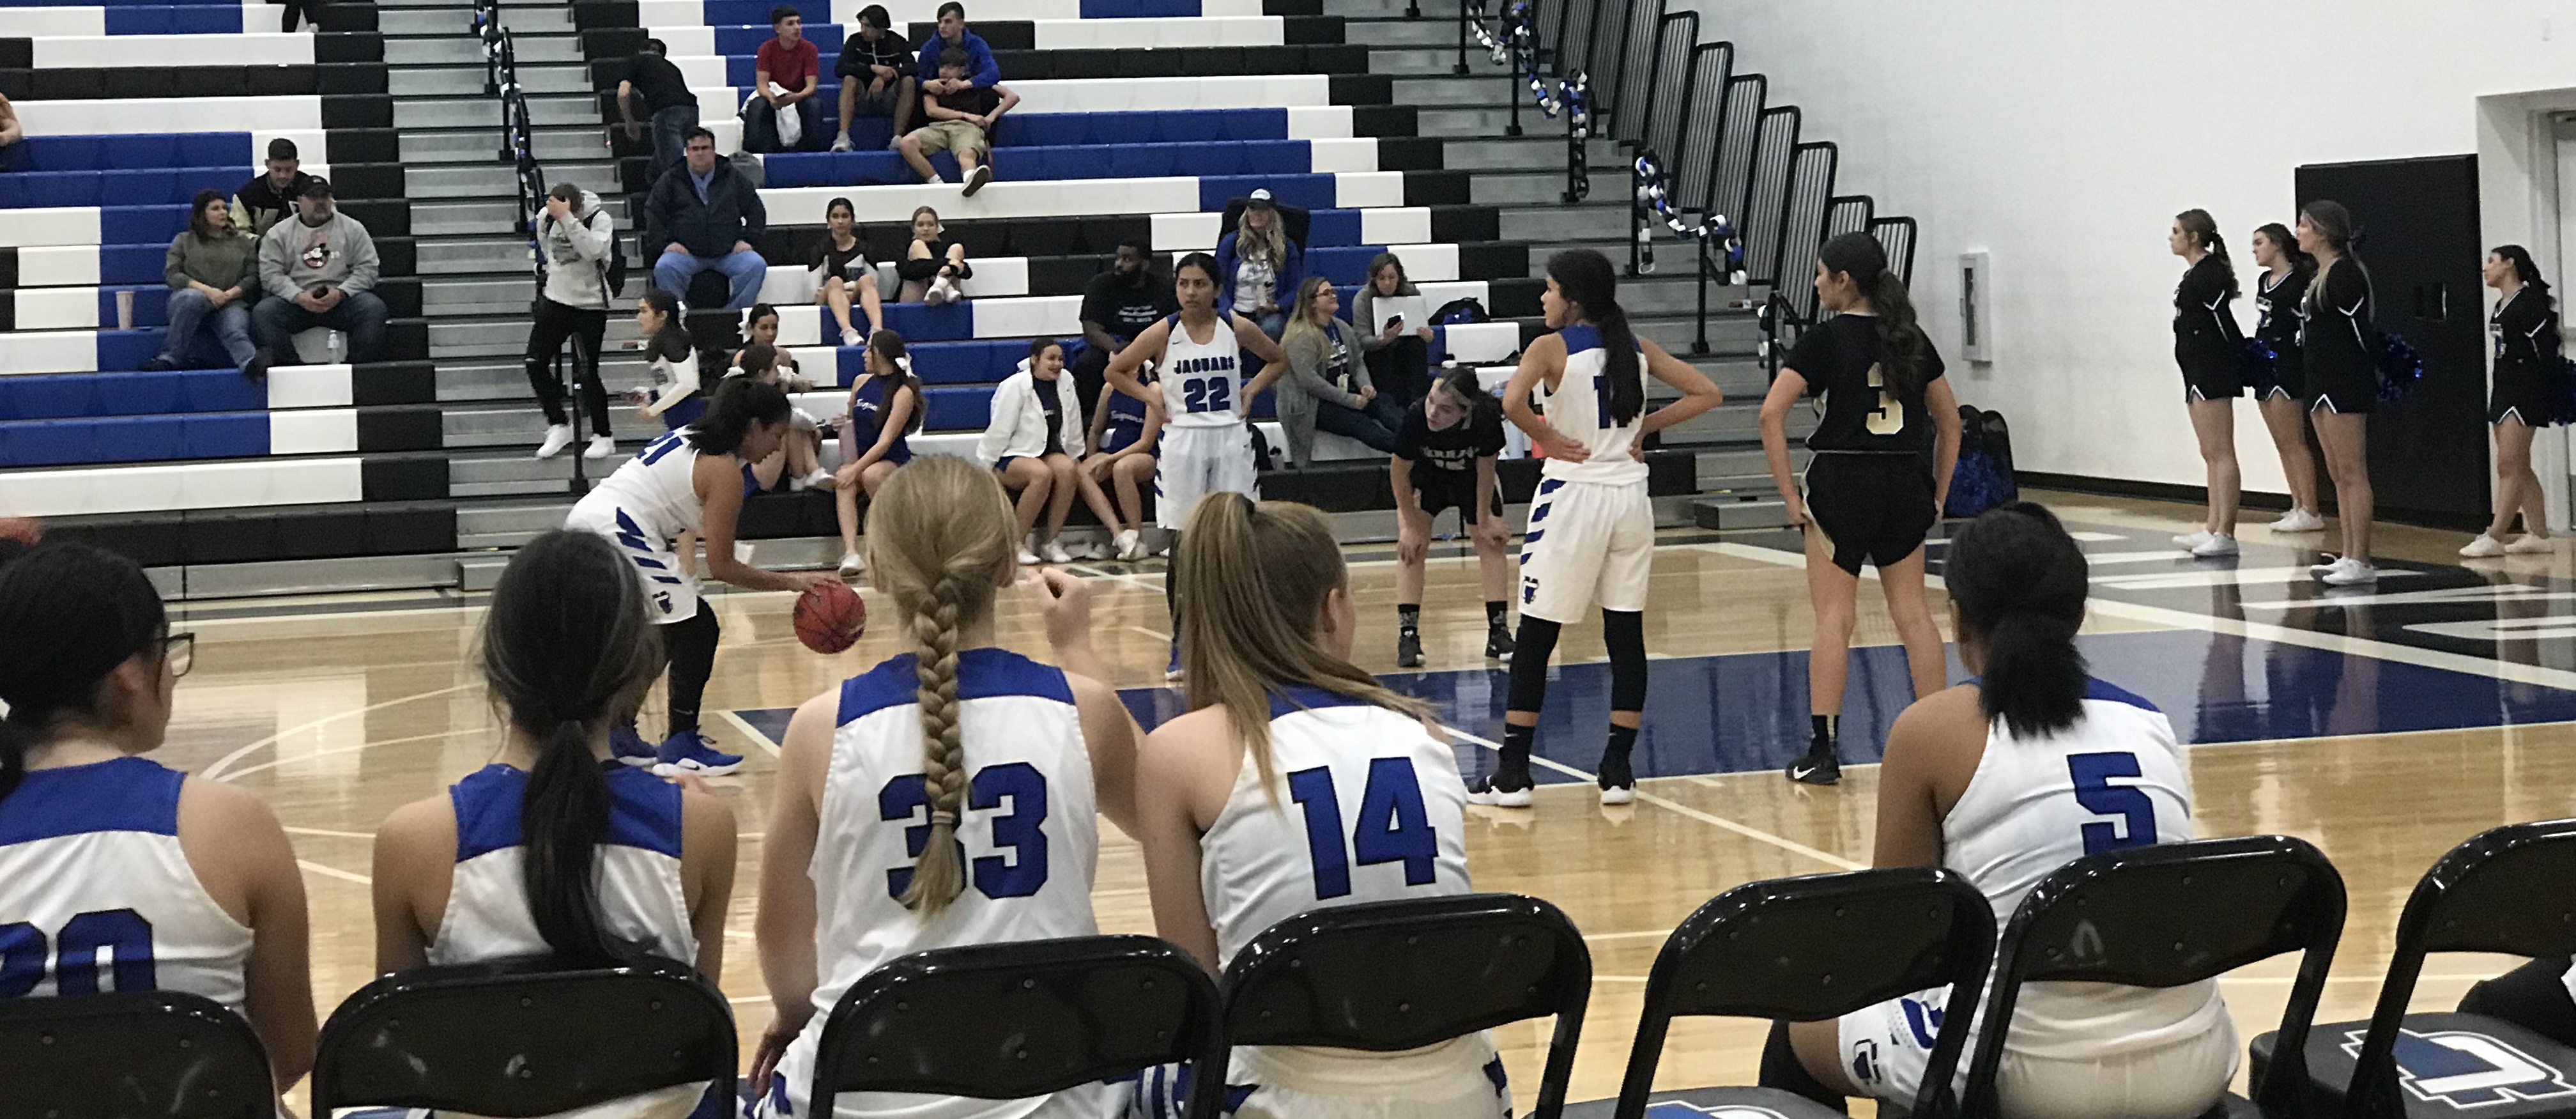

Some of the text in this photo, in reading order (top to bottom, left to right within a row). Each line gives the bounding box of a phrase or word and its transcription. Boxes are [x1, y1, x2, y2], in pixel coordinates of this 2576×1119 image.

[1174, 355, 1234, 374] JAGUARS
[1183, 376, 1230, 413] 22
[1866, 361, 1904, 435] 3
[878, 761, 1048, 910] 33
[1287, 756, 1440, 901] 14
[2066, 750, 2158, 855] 5
